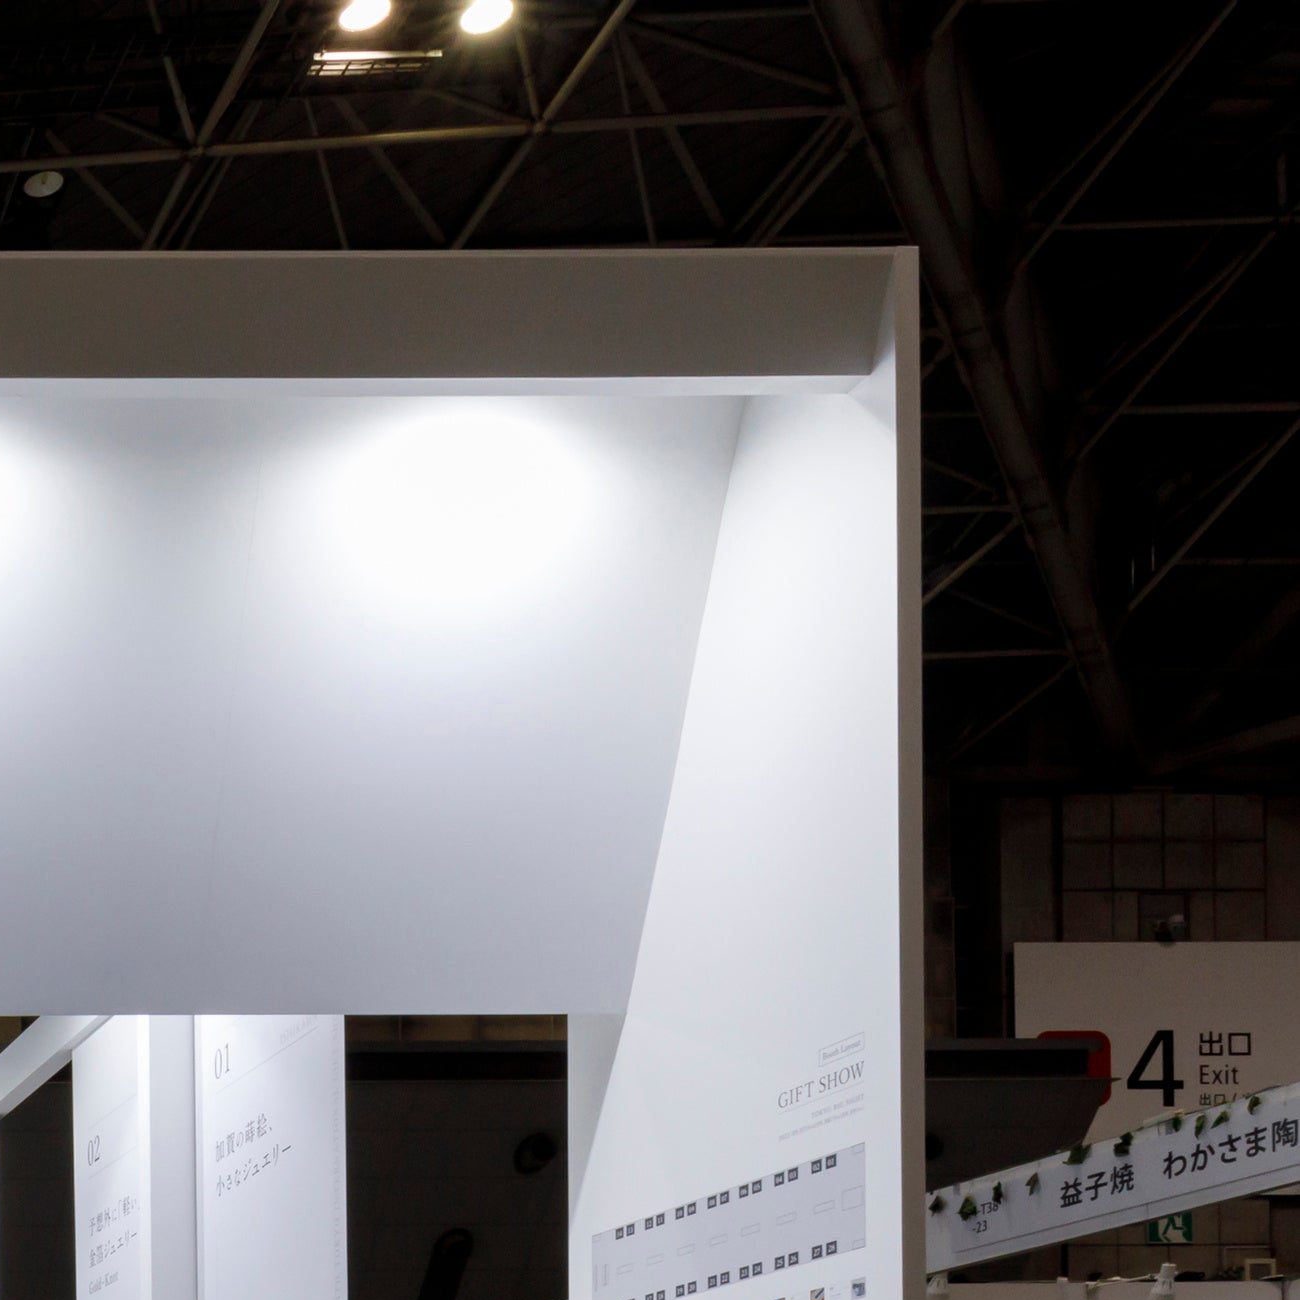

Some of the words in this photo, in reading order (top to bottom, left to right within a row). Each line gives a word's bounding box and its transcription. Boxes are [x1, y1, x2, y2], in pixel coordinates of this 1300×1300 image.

[214, 1042, 231, 1080] 01
[1199, 1031, 1252, 1056] 出口
[777, 1080, 815, 1109] GIFT
[818, 1060, 865, 1094] SHOW
[1127, 1030, 1184, 1107] 4
[1199, 1065, 1240, 1085] Exit
[87, 1134, 101, 1167] 02
[215, 1112, 273, 1163] 加賀の蒔絵、
[216, 1143, 292, 1198] 小さなジュエリー
[1059, 1164, 1135, 1209] 益子焼
[1162, 1118, 1300, 1180] わかさま陶
